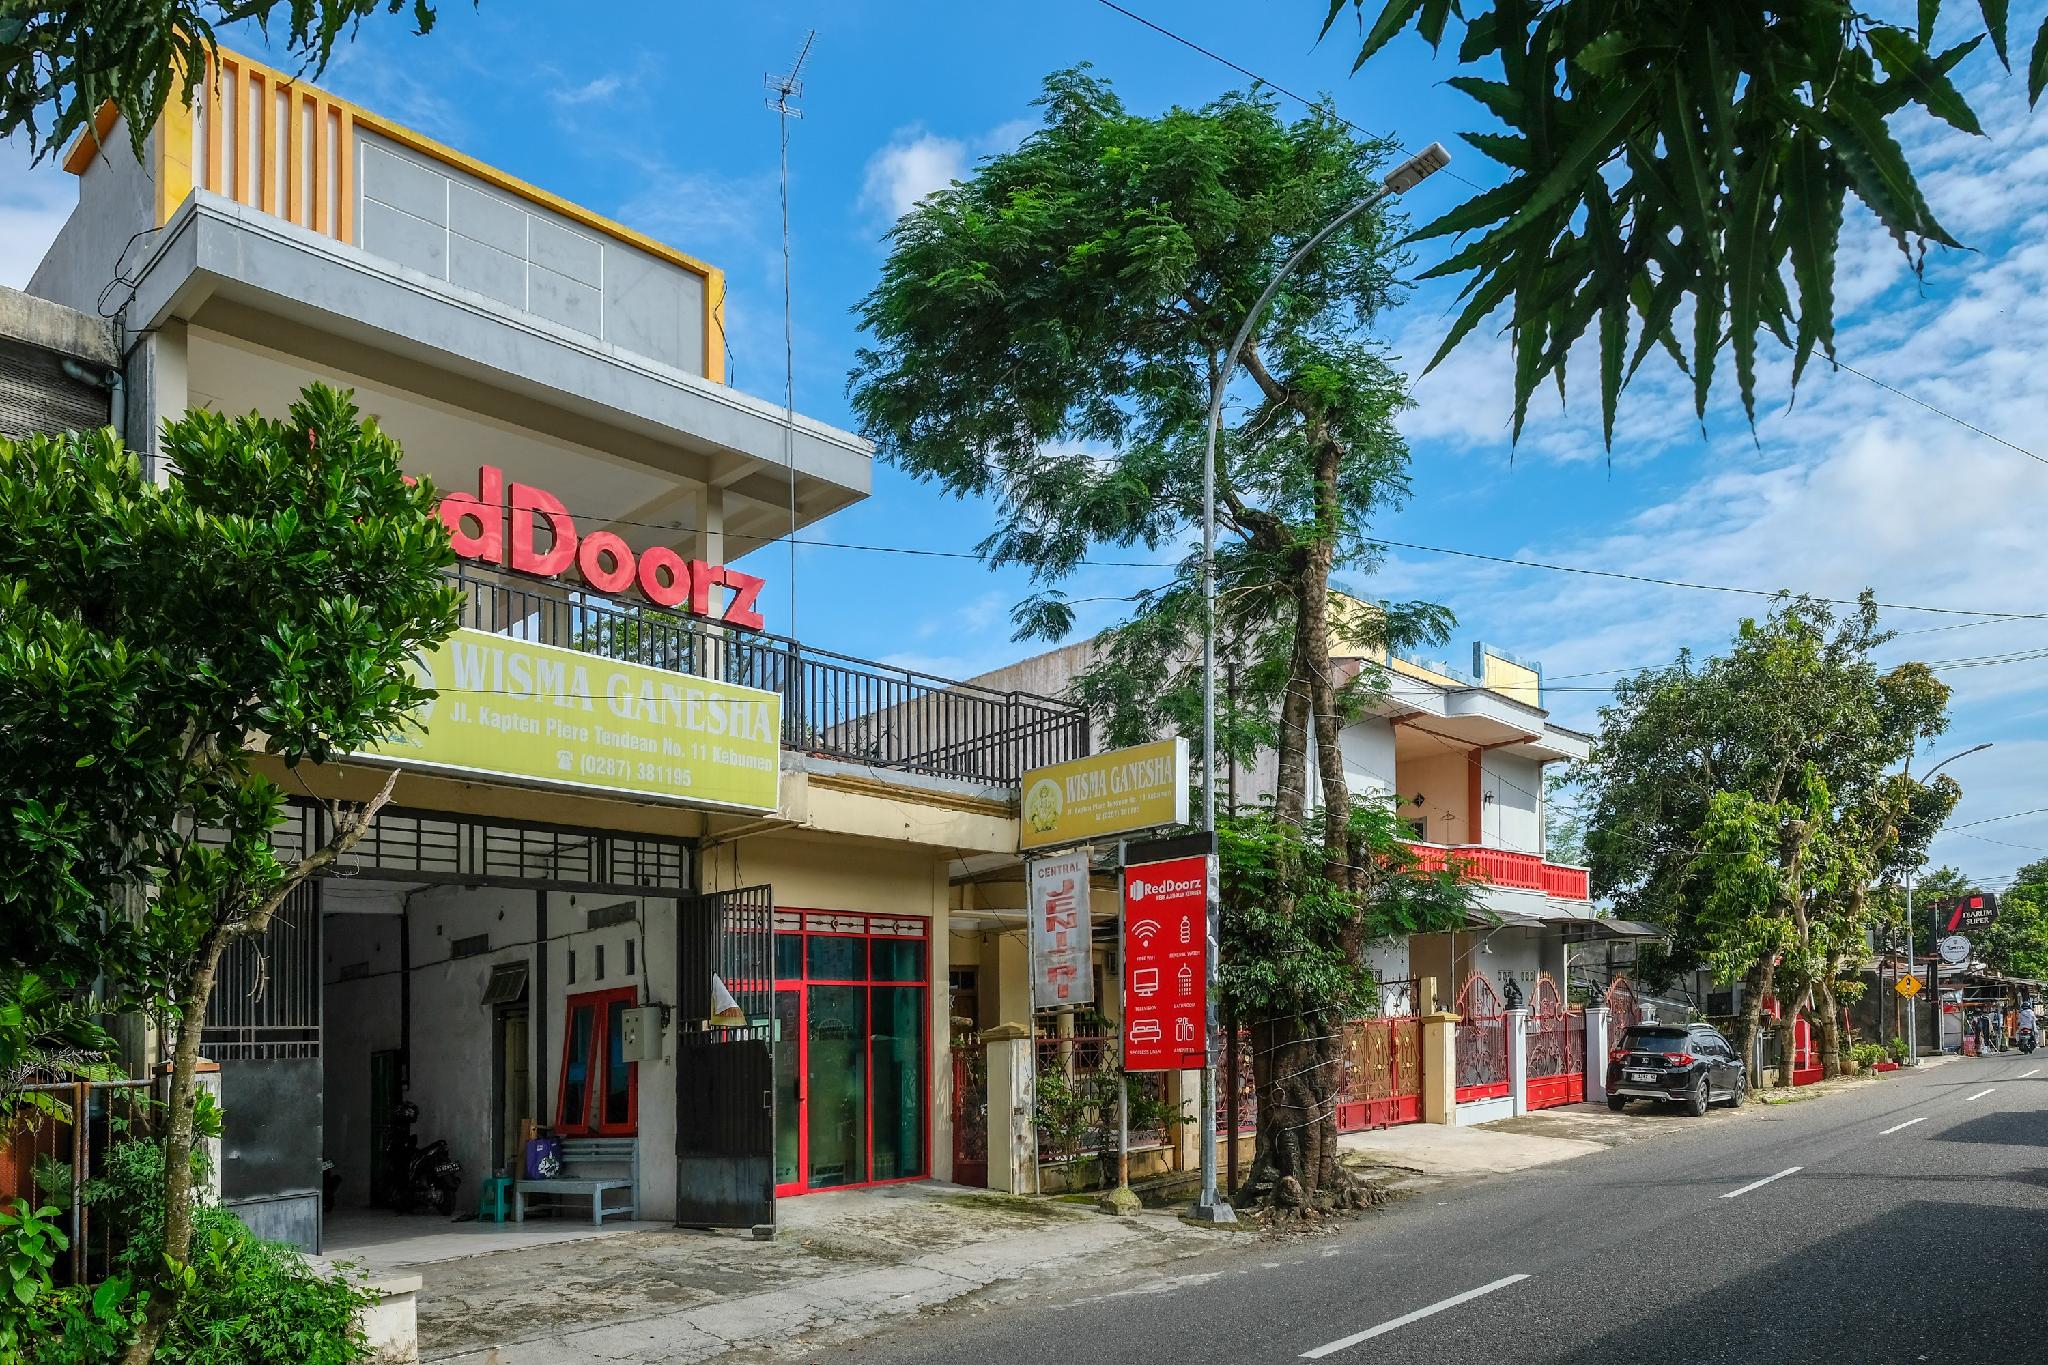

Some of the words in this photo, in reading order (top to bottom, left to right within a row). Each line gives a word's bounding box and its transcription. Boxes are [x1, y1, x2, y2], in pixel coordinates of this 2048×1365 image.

[401, 464, 766, 631] dDoorz
[451, 640, 593, 712] WISMA
[606, 672, 774, 744] GANESHA
[450, 702, 473, 723] Jl.
[479, 706, 540, 735] Kapten
[594, 725, 658, 753] Tendean
[662, 736, 686, 757] No.
[692, 743, 707, 761] 11
[581, 752, 631, 782] (0287)
[638, 762, 692, 787] 381195
[1066, 769, 1107, 804] WISMA
[1111, 755, 1173, 794] GANESHA
[1038, 862, 1081, 878] CENTRAL
[1144, 879, 1202, 896] RedDoorz
[1966, 917, 1990, 925] SUPER
